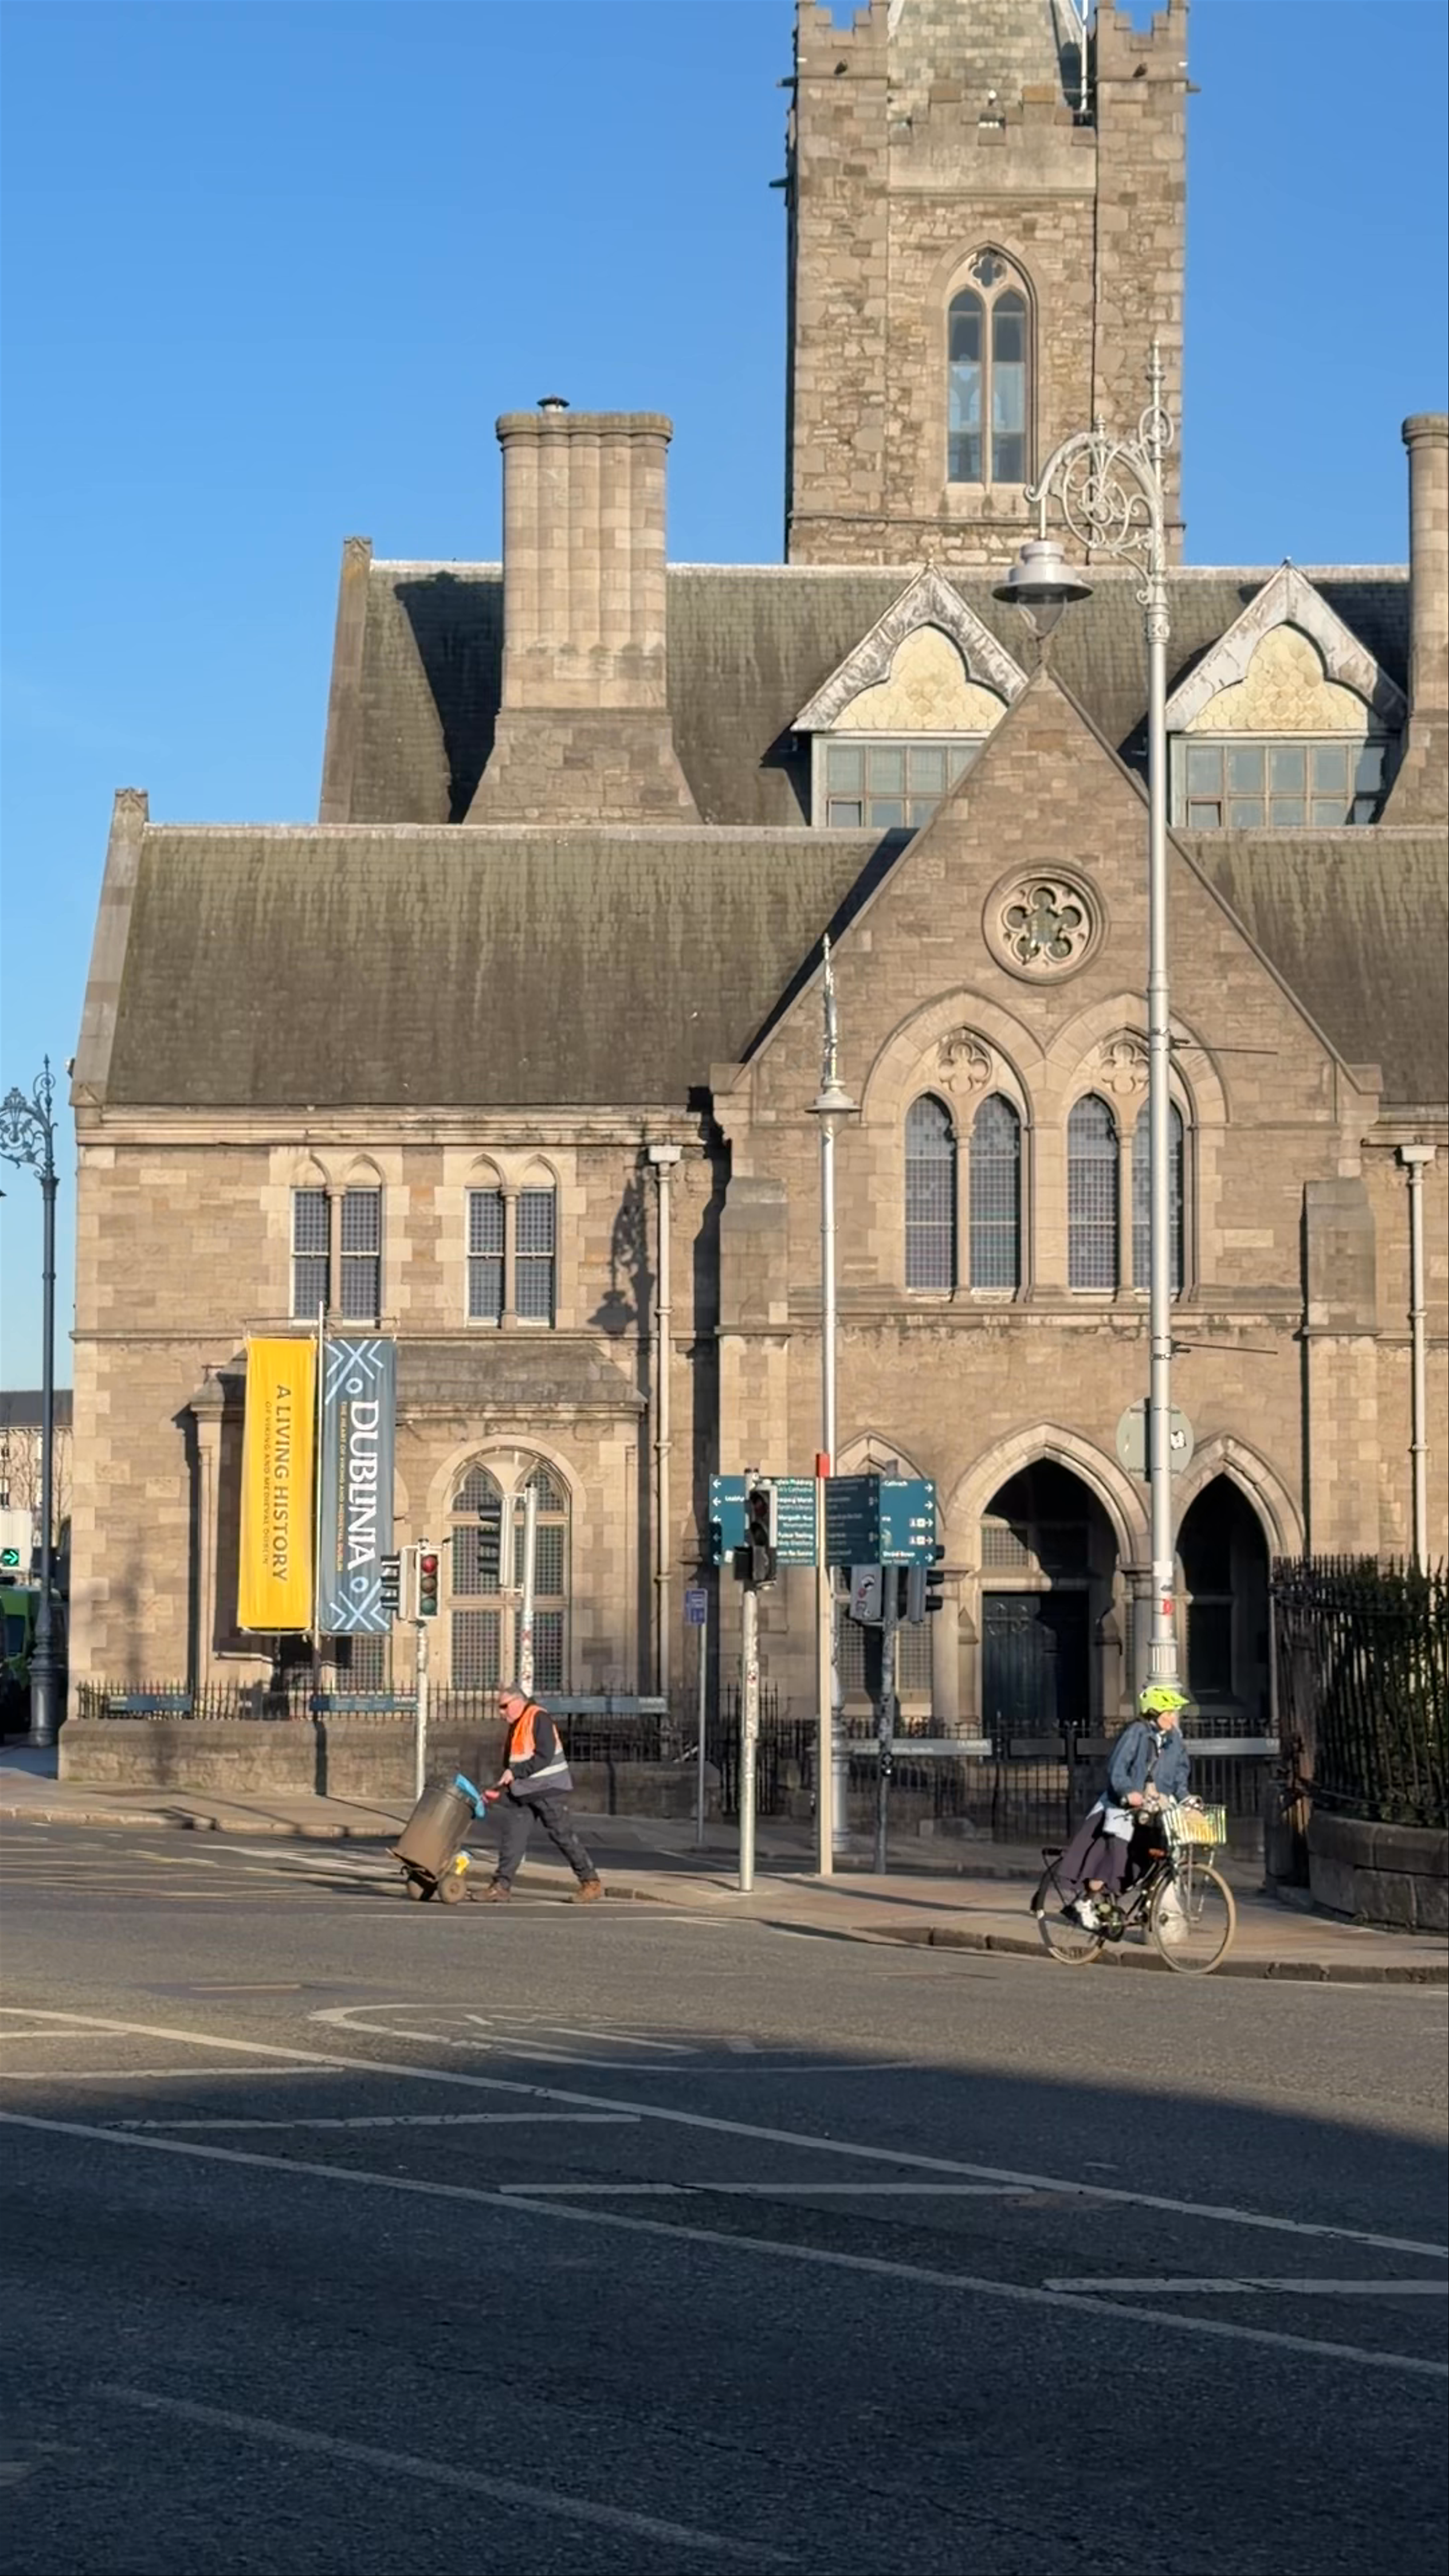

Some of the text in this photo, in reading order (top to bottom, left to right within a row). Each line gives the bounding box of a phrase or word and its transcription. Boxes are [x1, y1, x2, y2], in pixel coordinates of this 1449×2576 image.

[265, 1401, 272, 1414] OF
[340, 1444, 347, 1455] OF
[272, 1385, 291, 1581] A LIVING HISTORY
[347, 1399, 379, 1571] DUBLINIA
